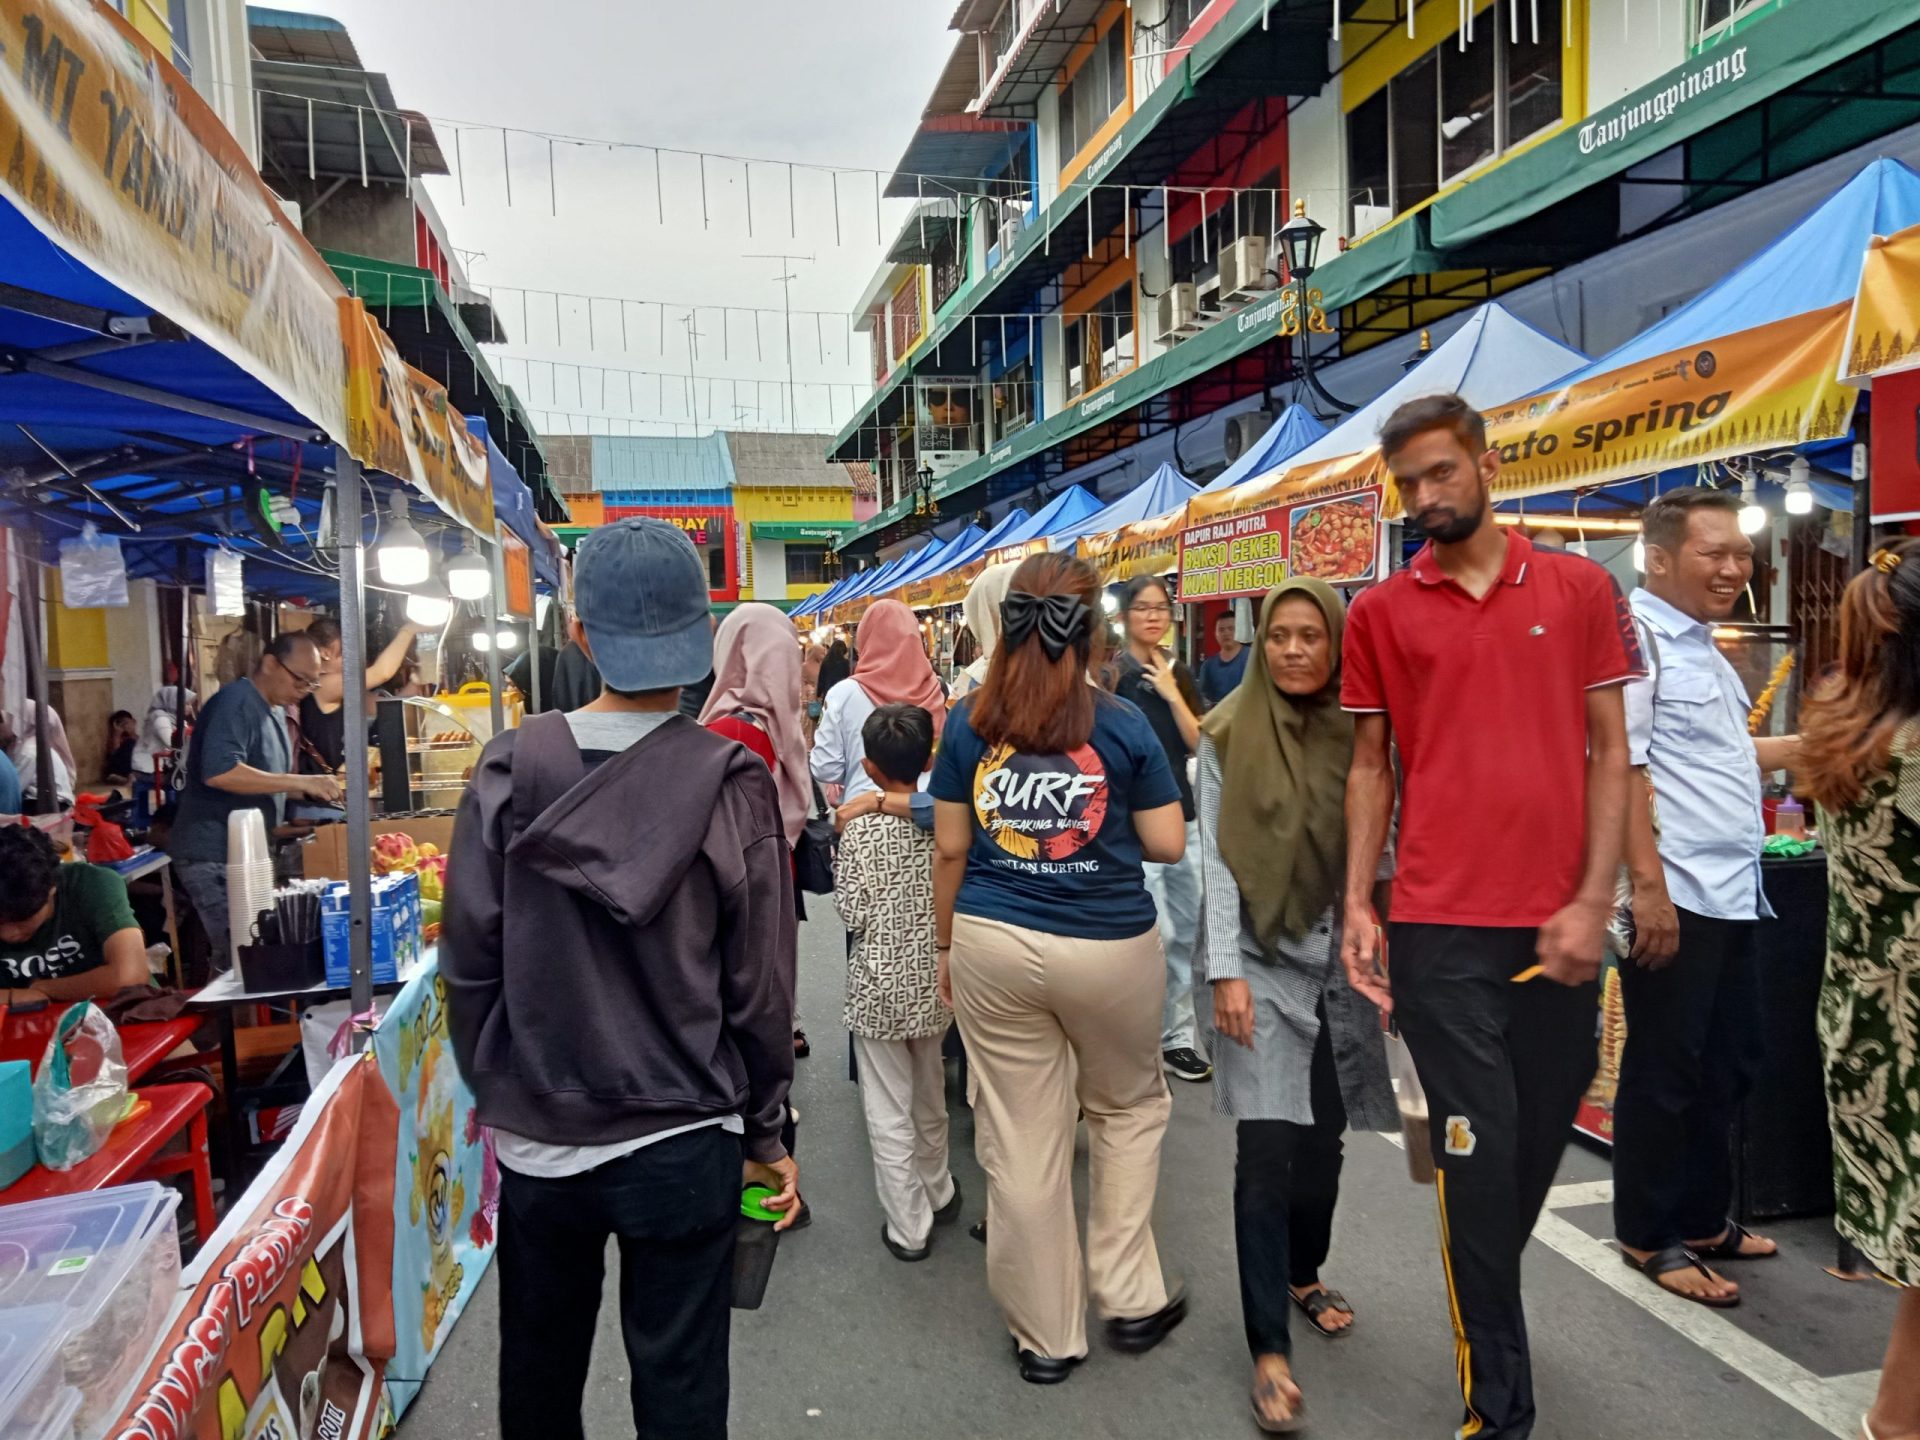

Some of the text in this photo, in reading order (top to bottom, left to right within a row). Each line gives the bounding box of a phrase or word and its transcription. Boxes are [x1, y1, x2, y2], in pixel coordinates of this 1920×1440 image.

[1578, 45, 1748, 154] Tanjungpinang
[1571, 390, 1734, 453] spring
[1184, 515, 1267, 546] DAPUR RAJA PUTRA
[1183, 541, 1227, 571] BAKSO
[1230, 533, 1281, 563] CEKER
[1182, 561, 1287, 597] KUAH MERCON
[977, 768, 1105, 817] SURF
[990, 816, 1091, 833] BREAKING WAVES
[1041, 859, 1099, 875] SURFING
